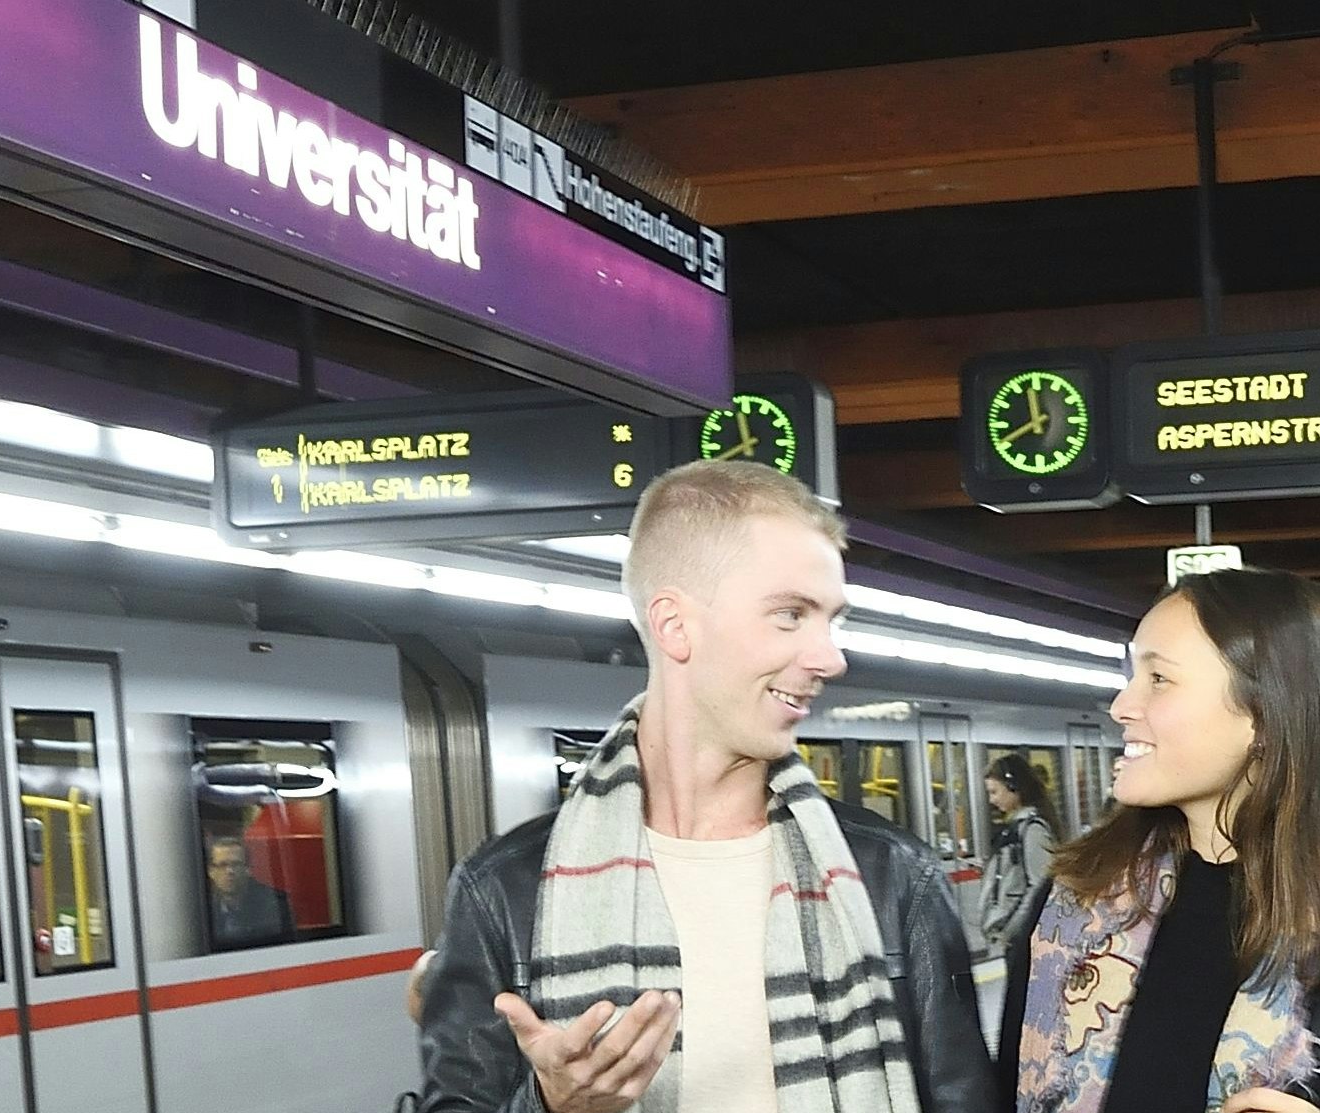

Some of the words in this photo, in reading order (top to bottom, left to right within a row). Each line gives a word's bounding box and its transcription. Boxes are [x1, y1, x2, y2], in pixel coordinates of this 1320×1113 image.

[138, 13, 481, 271] Universität
[563, 158, 702, 273] Hohenstaufeng.
[1157, 373, 1308, 406] SEESTADT
[306, 433, 470, 466] KARLSPLATZ
[307, 473, 472, 507] KARLSPLATZ
[613, 463, 634, 488] 6
